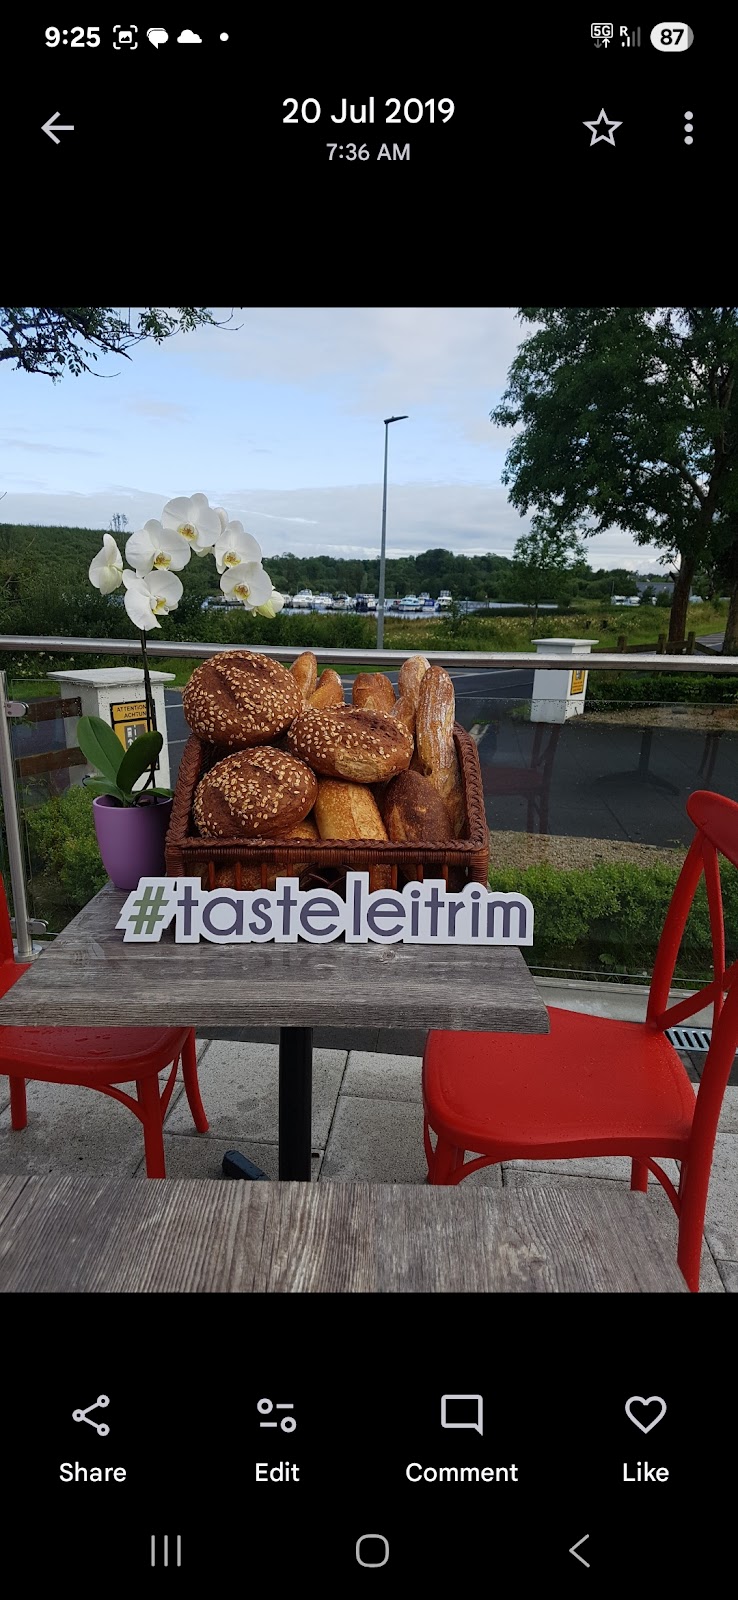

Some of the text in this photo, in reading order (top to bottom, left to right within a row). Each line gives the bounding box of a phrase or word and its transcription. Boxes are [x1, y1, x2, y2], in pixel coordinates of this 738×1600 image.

[117, 704, 147, 712] ATTENTION
[124, 711, 147, 719] ACHTUN
[129, 879, 528, 939] #tasteleitrim
